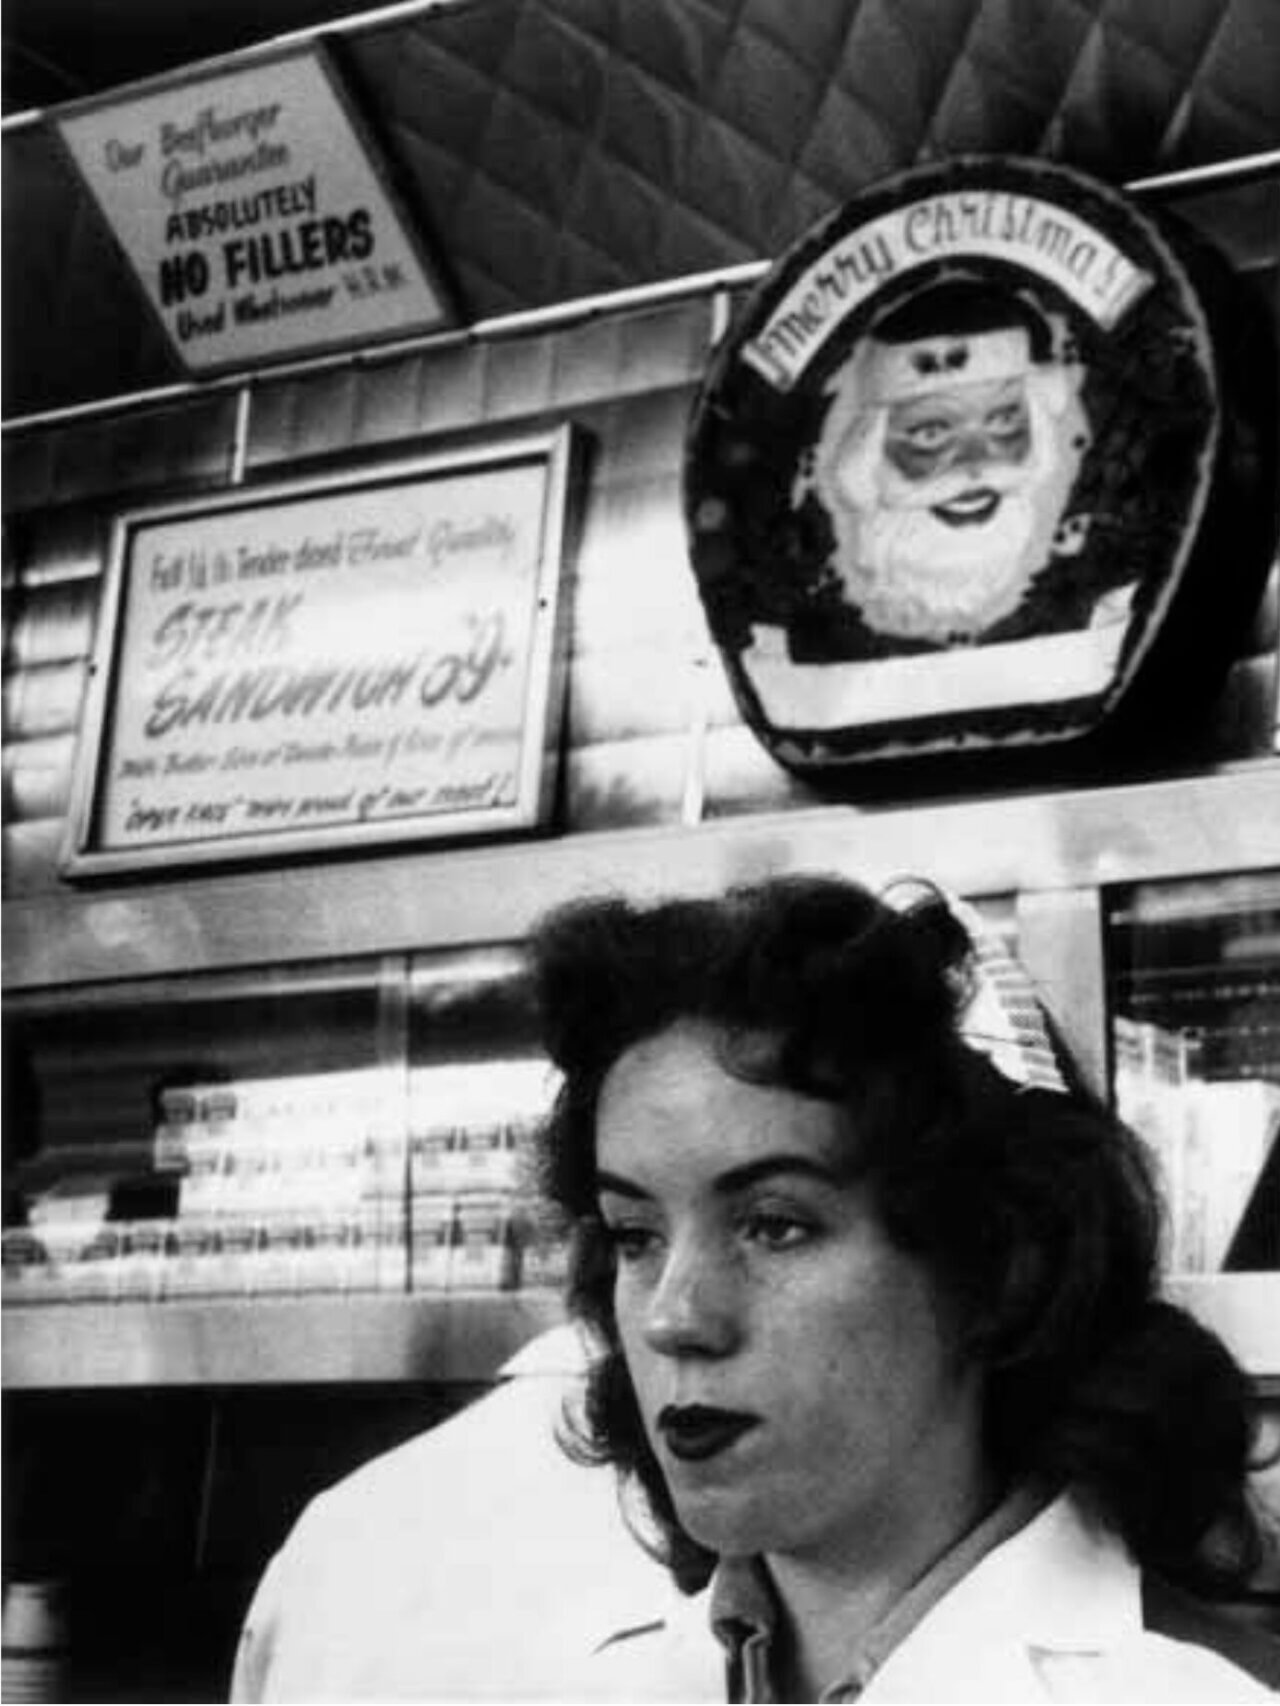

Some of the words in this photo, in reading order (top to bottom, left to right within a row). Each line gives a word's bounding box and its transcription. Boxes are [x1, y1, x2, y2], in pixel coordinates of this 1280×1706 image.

[105, 139, 144, 173] Our
[165, 173, 317, 244] ABSOLUTELY
[158, 251, 210, 307] NO
[223, 208, 375, 288] FILLERS
[144, 590, 304, 669] STEAK
[144, 650, 418, 739] SANDWICH
